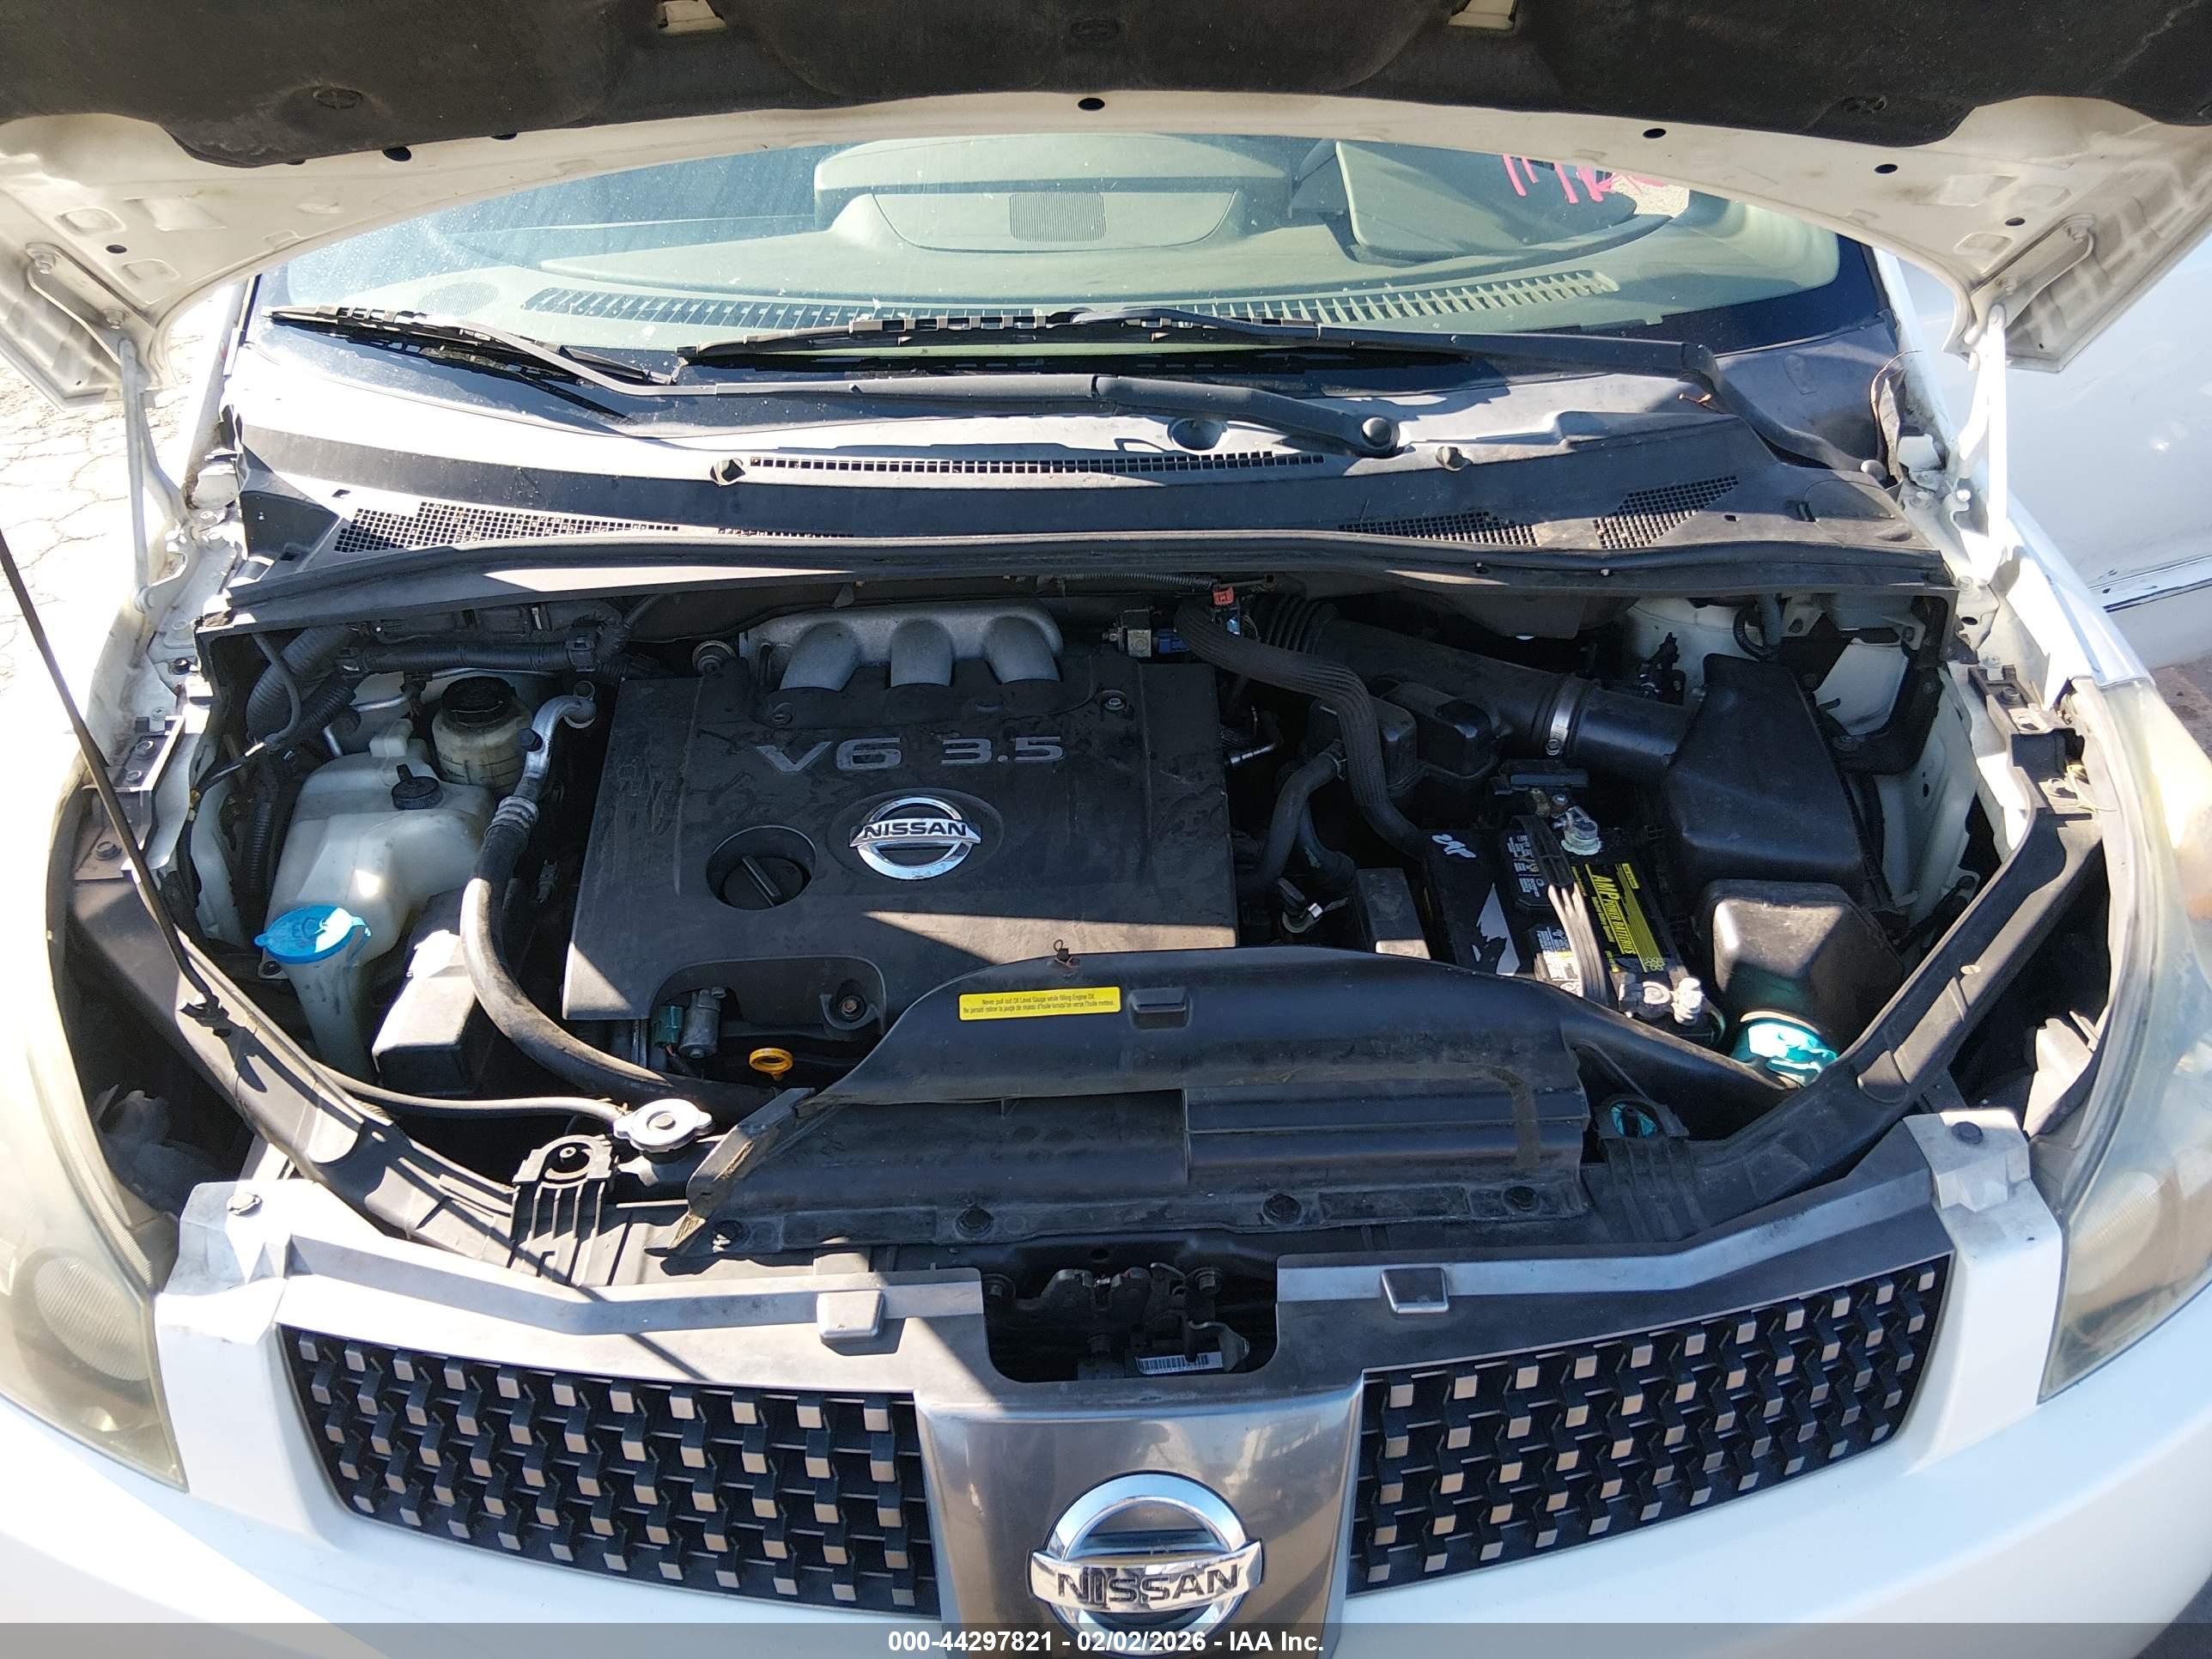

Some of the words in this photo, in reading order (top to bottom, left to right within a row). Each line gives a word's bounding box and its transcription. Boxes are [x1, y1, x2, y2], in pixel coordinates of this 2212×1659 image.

[756, 738, 901, 772] V6
[941, 737, 1064, 764] 3.5
[864, 821, 966, 838] NISSAN
[1592, 874, 1620, 900] AMP
[1057, 1565, 1238, 1604] NISSAN
